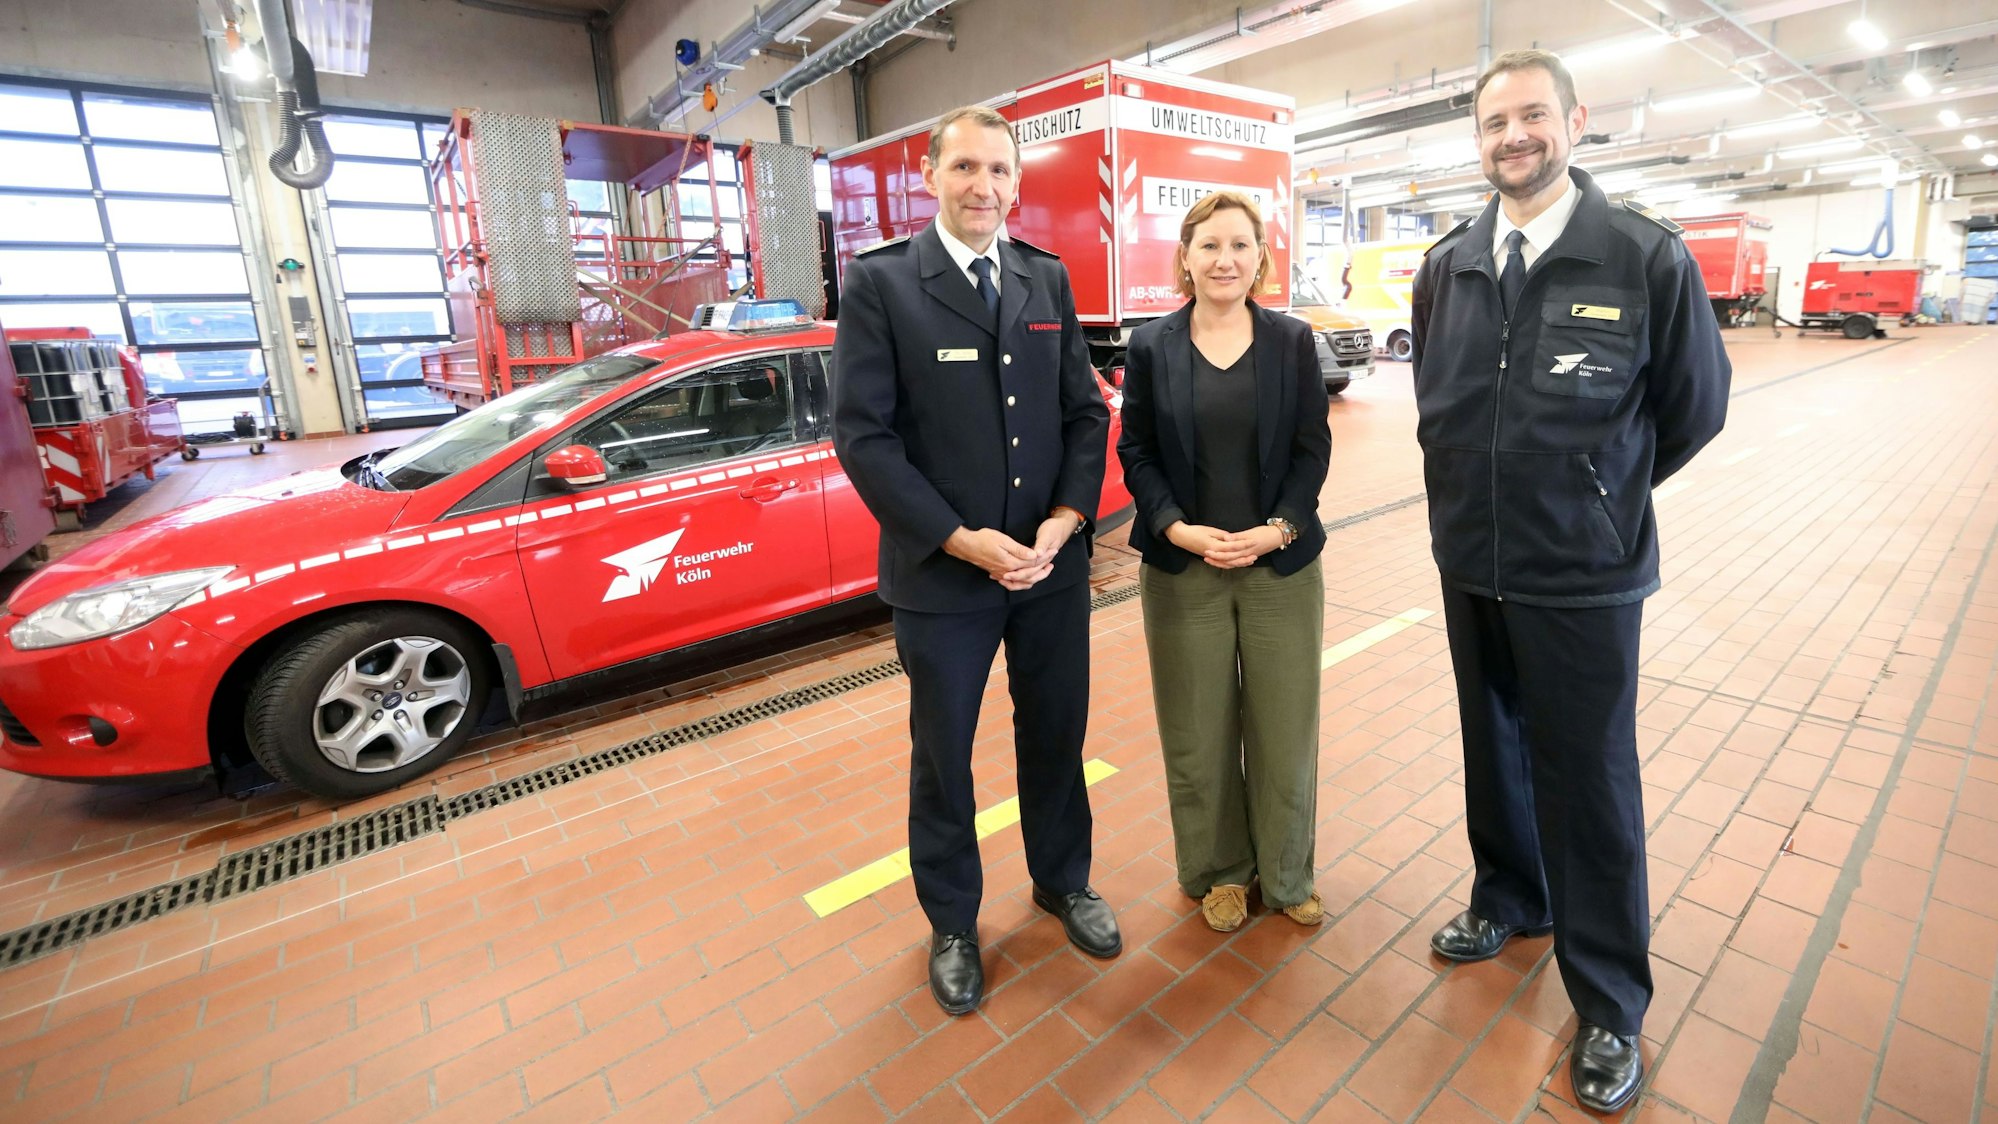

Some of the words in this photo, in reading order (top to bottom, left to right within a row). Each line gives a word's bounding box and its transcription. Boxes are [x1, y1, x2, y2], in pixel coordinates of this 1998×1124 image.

[1011, 108, 1081, 144] ELTSCHUTZ
[1152, 106, 1266, 144] UMWELTSCHUTZ
[1578, 370, 1593, 378] Köln
[1579, 363, 1613, 373] Feuerwehr
[673, 541, 754, 568] Feuerwehr
[676, 567, 711, 585] Köln
